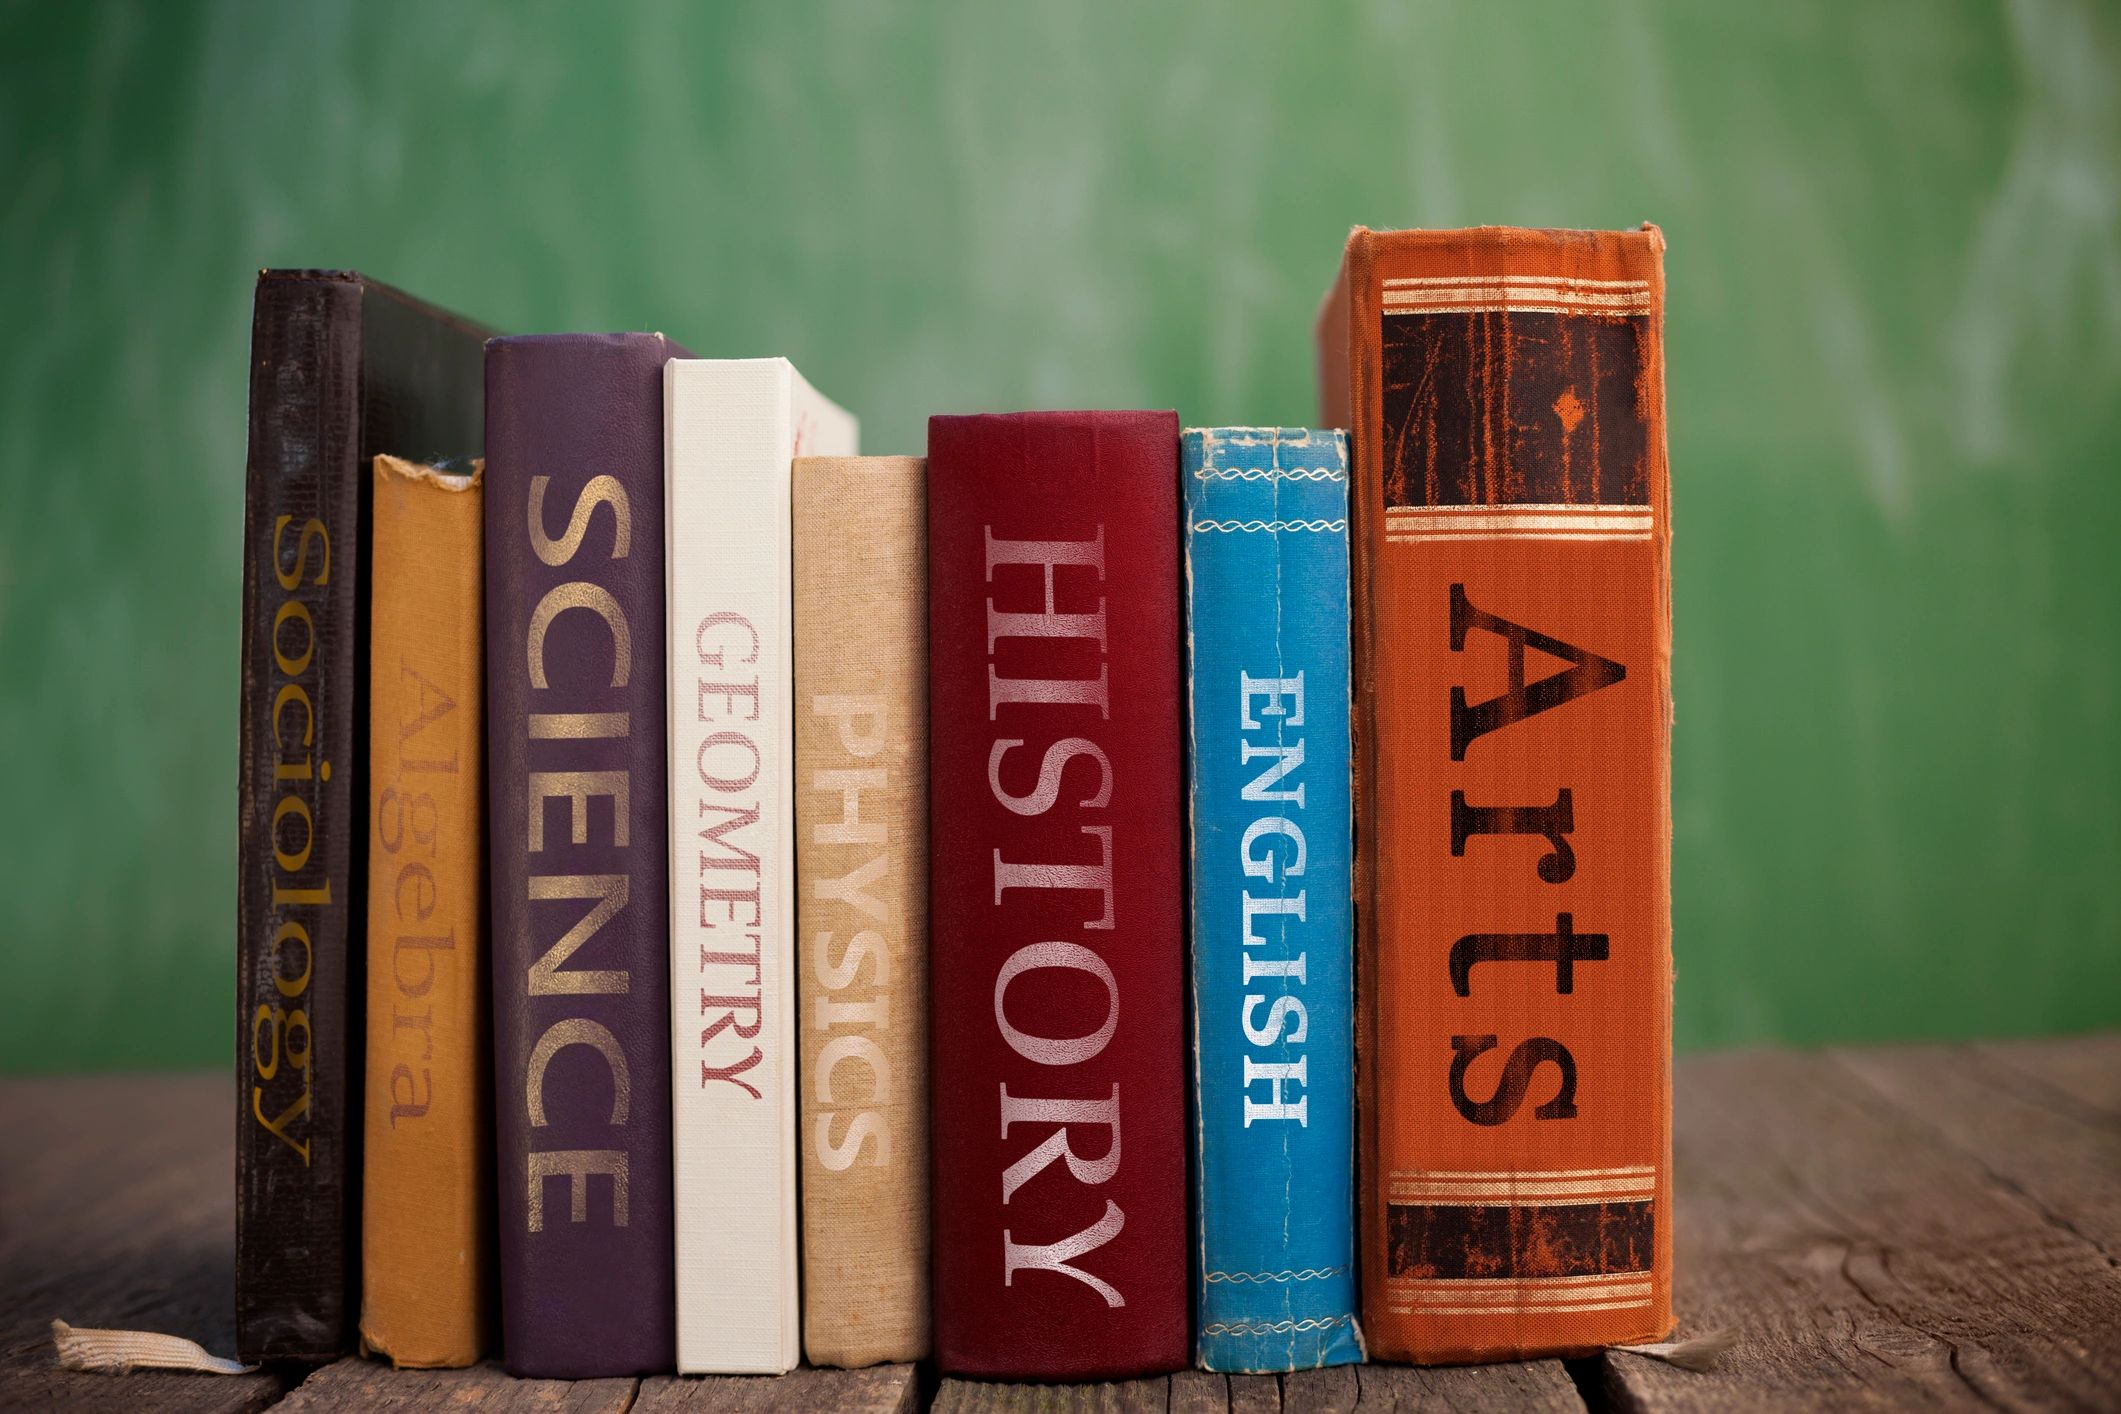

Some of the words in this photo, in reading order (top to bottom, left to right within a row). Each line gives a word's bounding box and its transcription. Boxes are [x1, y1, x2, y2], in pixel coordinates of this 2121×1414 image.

[253, 514, 332, 1166] Sociology
[378, 658, 461, 1129] Algebra
[526, 473, 633, 1233] SCIENCE
[696, 611, 763, 1100] GEOMETRY
[812, 693, 890, 1173] PHYSICS
[982, 523, 1127, 1308] HISTORY
[1239, 670, 1309, 1128] ENGLISH
[1449, 583, 1627, 1125] Arts
